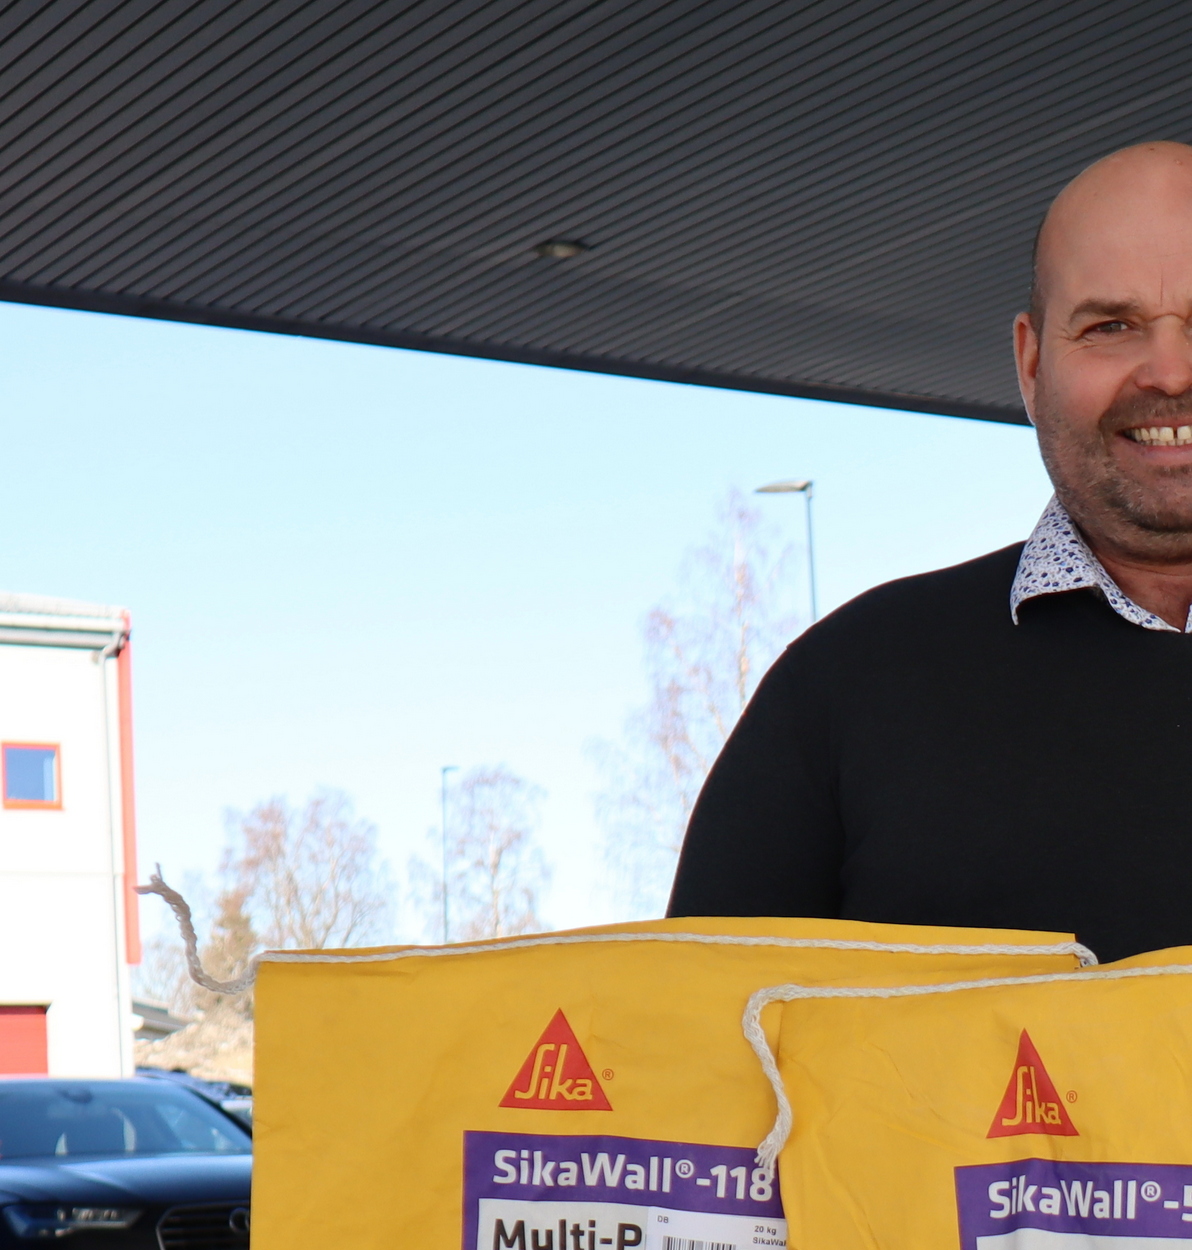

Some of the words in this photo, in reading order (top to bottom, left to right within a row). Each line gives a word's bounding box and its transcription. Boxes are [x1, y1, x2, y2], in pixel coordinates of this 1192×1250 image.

[515, 1043, 594, 1101] Sika
[1001, 1065, 1062, 1126] Sika
[657, 1215, 669, 1224] DB
[754, 1225, 764, 1233] 20
[767, 1226, 777, 1236] kg
